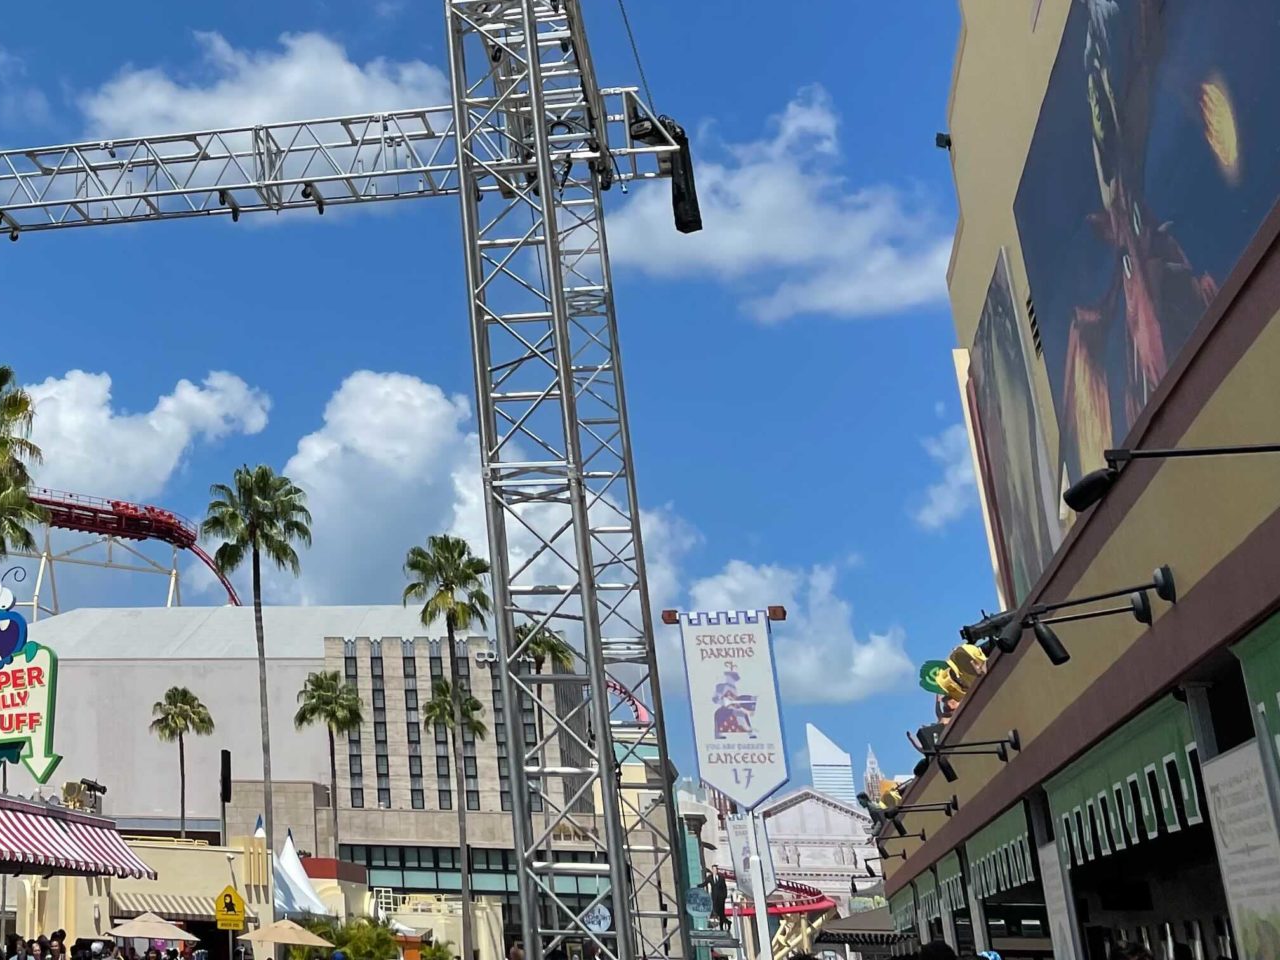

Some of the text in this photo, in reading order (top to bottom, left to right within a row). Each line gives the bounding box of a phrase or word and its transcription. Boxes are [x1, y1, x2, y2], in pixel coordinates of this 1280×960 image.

[696, 633, 757, 646] STROLLER
[700, 646, 755, 662] PARKING
[707, 752, 776, 764] LANCELOT
[732, 768, 755, 788] 17
